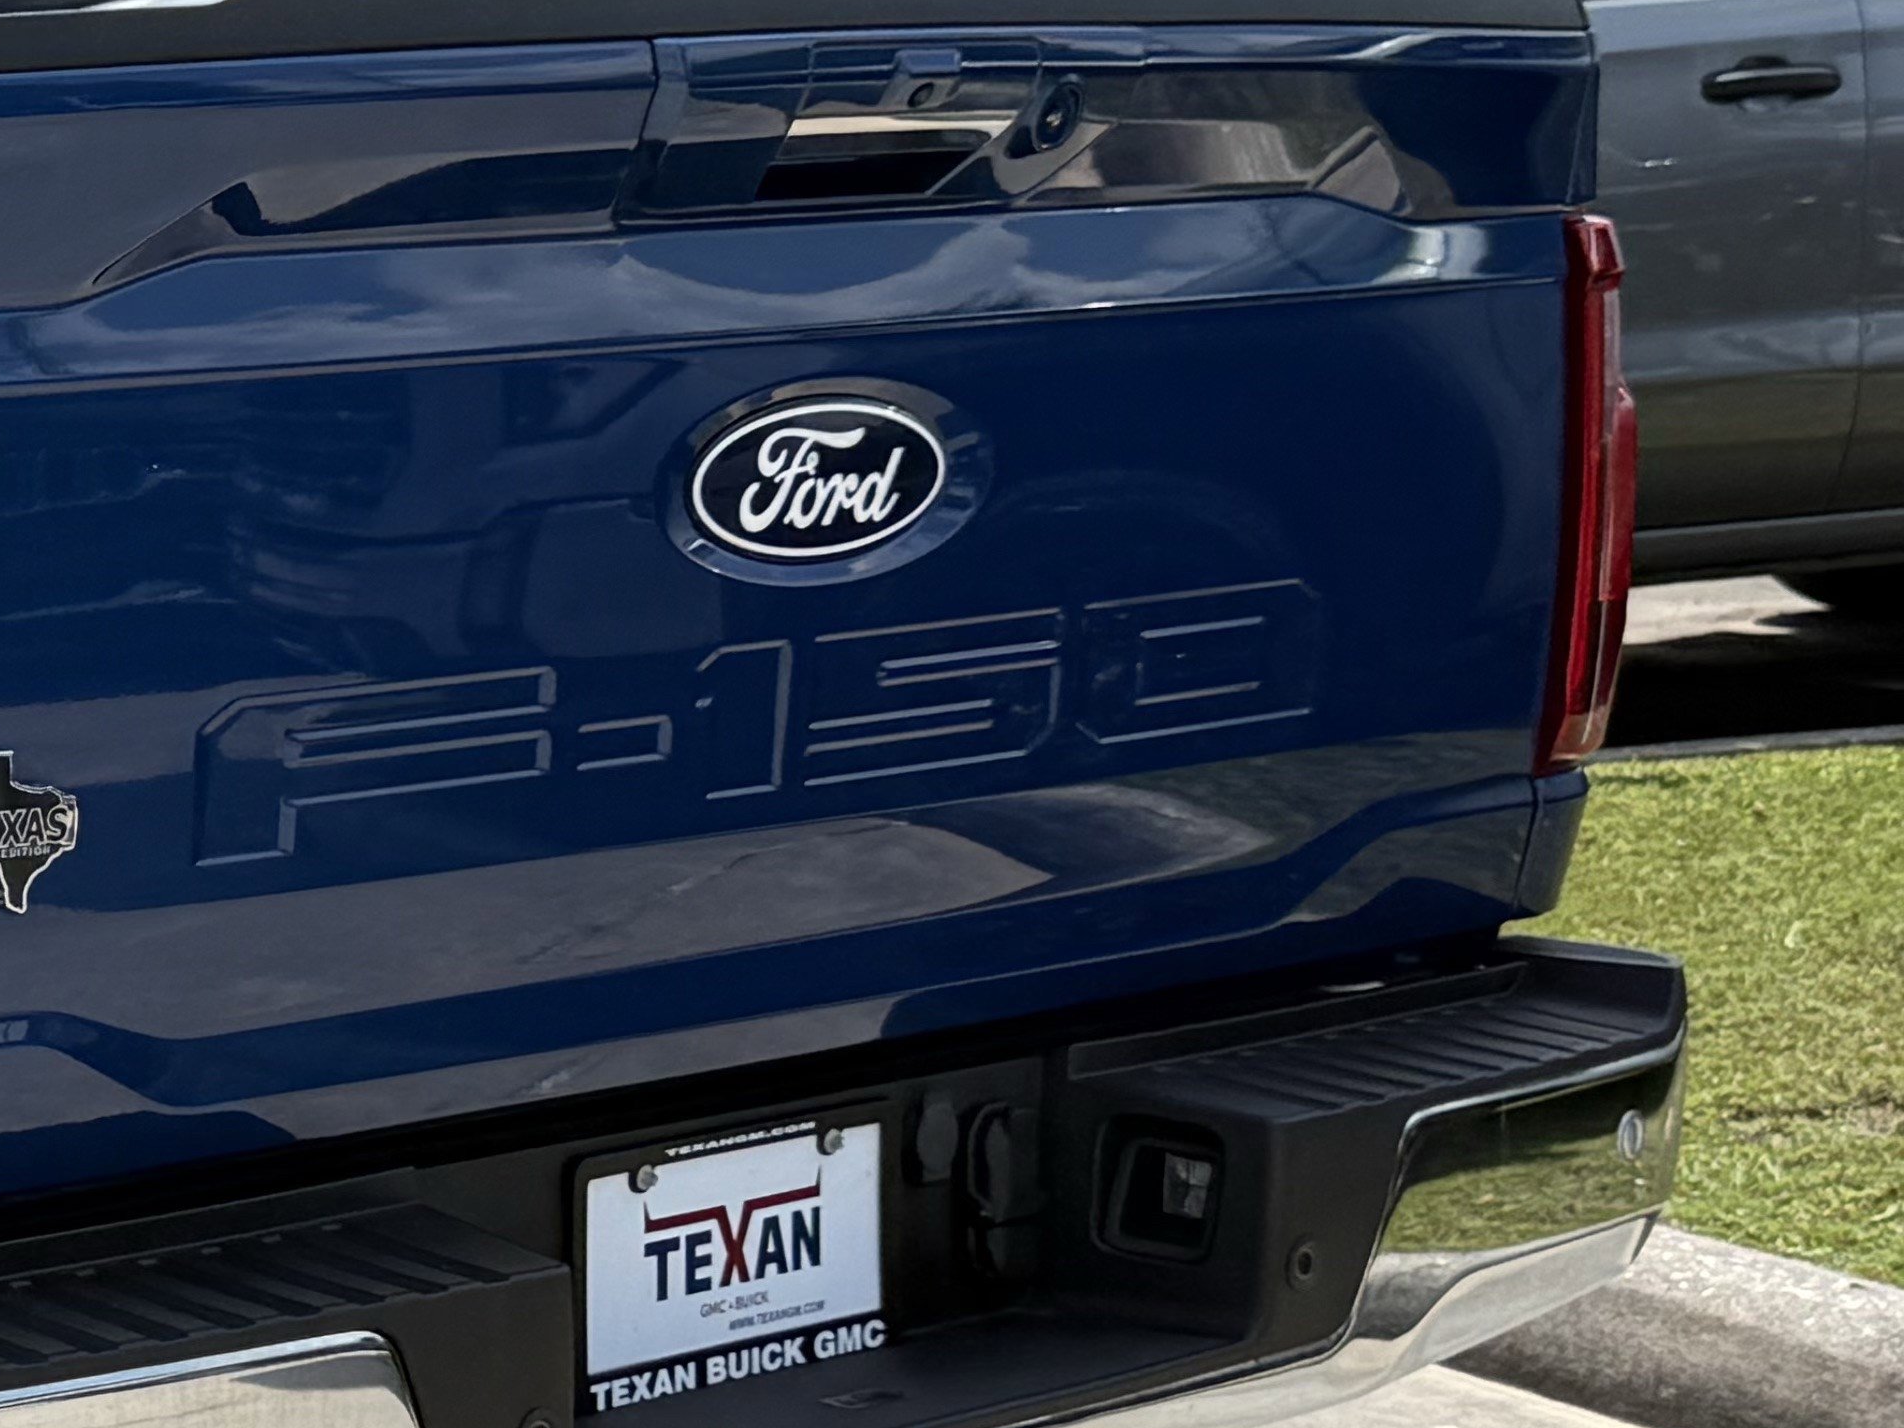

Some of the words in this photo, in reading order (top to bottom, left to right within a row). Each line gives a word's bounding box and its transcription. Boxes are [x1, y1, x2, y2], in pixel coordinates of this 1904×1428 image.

[737, 423, 900, 533] Ford
[195, 578, 1320, 866] F-150
[0, 845, 51, 859] EDITION
[643, 1183, 823, 1301] TEXAN
[590, 1361, 697, 1412] TEXAN
[706, 1335, 807, 1387] BUICK
[814, 1319, 886, 1360] GMC
